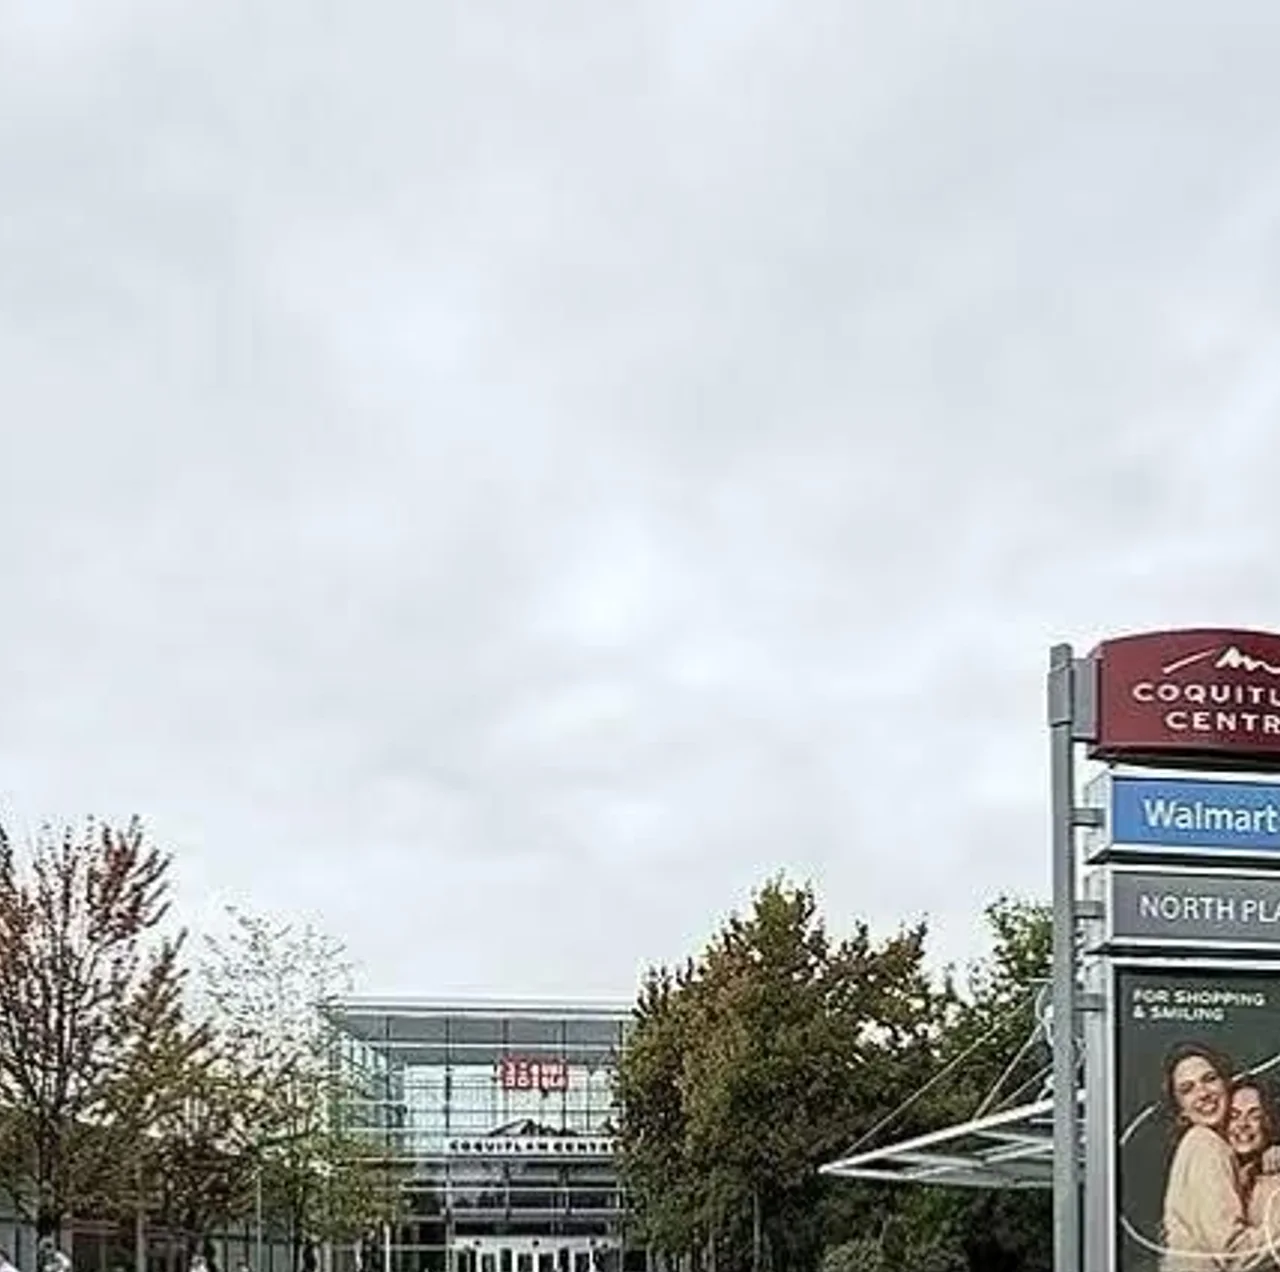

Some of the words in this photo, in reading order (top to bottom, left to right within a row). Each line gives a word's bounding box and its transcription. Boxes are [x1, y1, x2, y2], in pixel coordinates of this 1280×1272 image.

[1143, 799, 1278, 834] Walmart
[1140, 896, 1233, 921] NORTH
[1133, 989, 1170, 1003] FOR
[1173, 990, 1266, 1006] SHOPPING
[1150, 1005, 1224, 1021] SMILING
